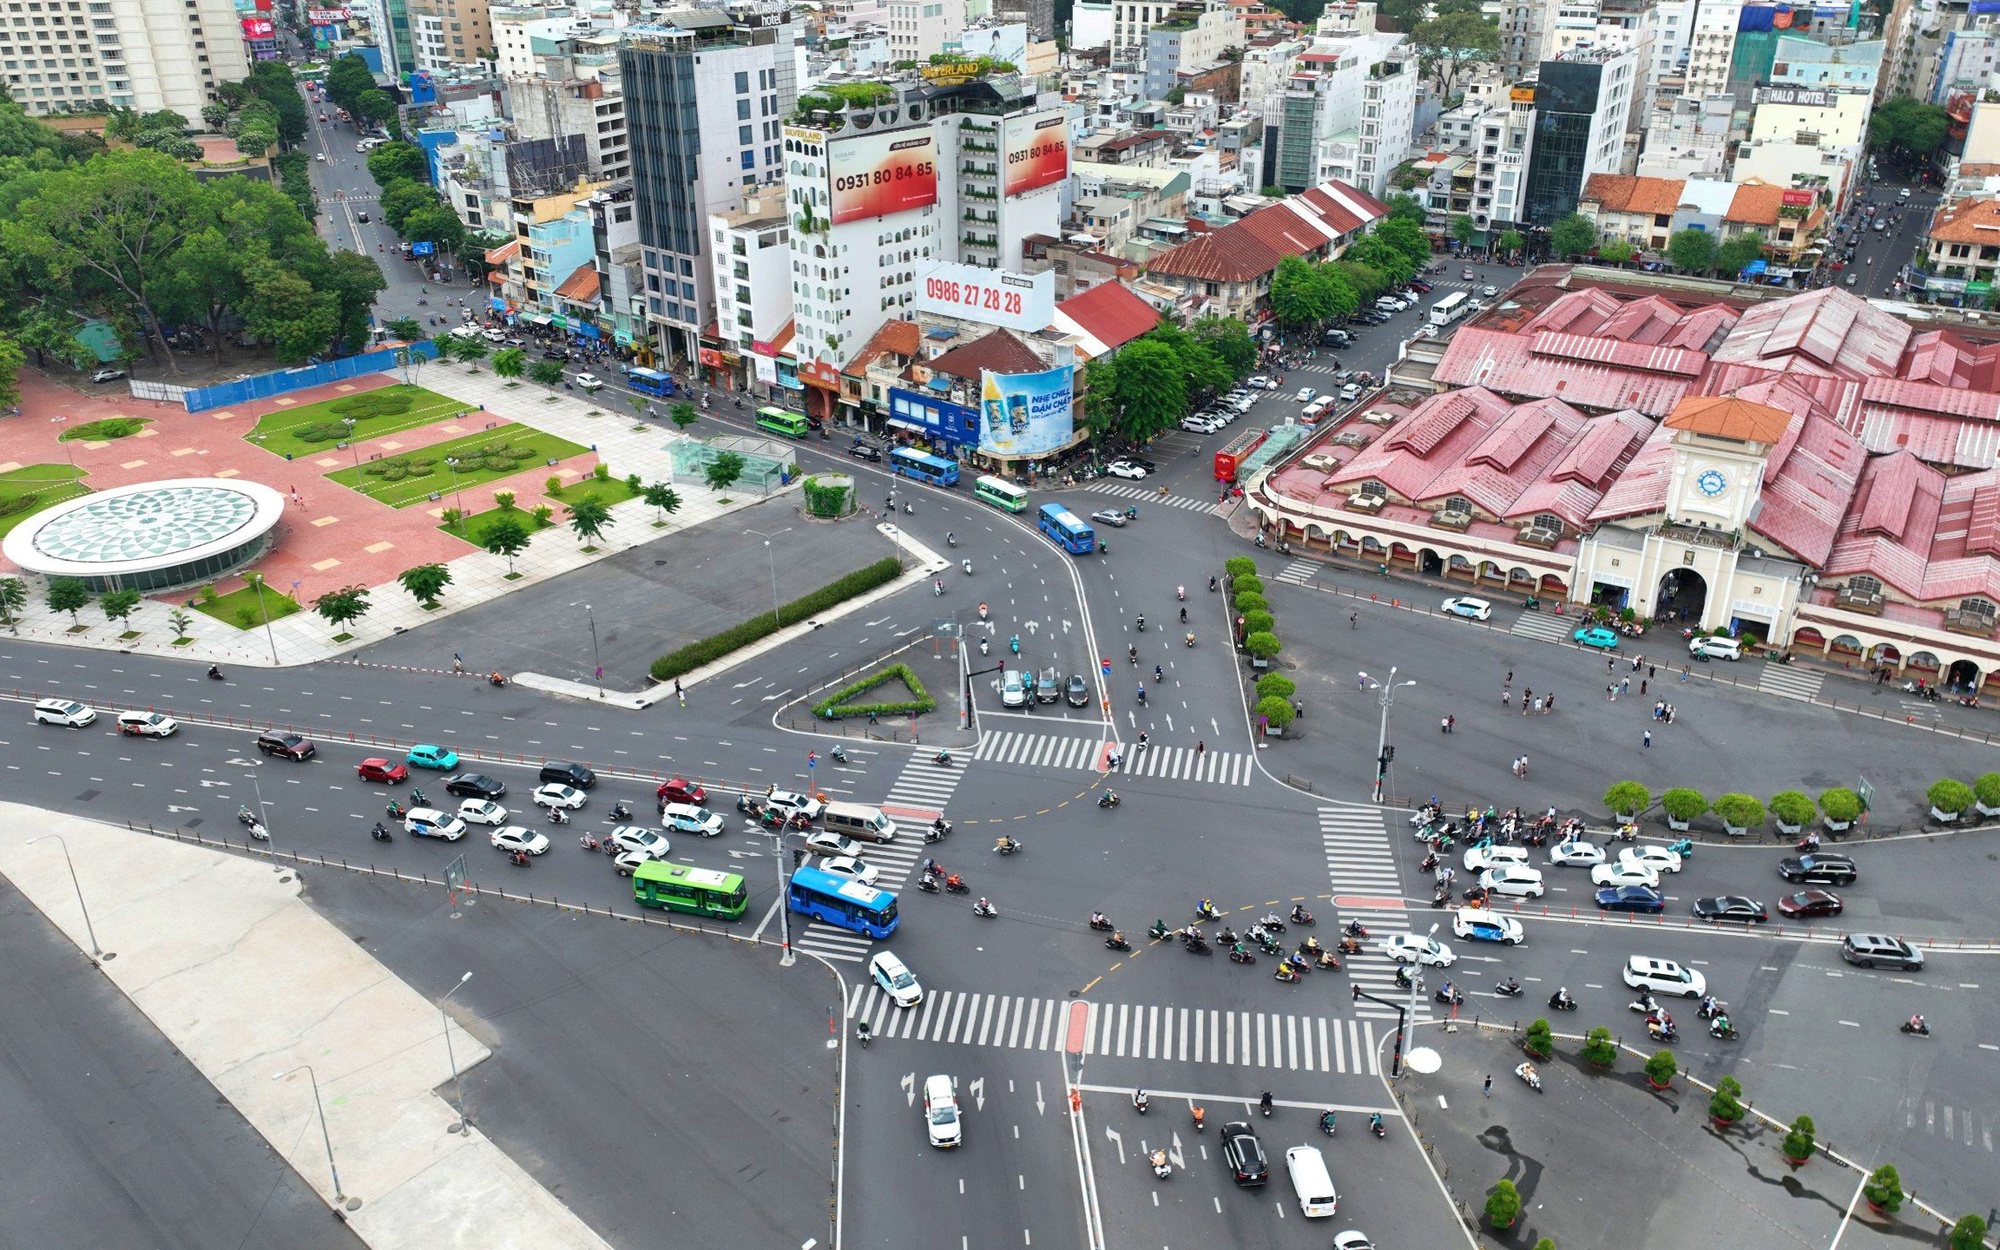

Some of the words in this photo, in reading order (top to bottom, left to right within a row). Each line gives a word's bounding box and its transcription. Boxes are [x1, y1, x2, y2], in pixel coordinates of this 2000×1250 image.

[761, 13, 782, 27] hotel
[921, 62, 979, 78] SILVERLAND
[1770, 89, 1794, 103] HALO
[1797, 91, 1826, 104] HOTEL
[784, 128, 823, 140] SILVERLAND
[1008, 149, 1028, 164] 0931
[1030, 146, 1041, 159] 80
[1042, 143, 1053, 156] 84
[1054, 141, 1065, 153] 85
[836, 172, 869, 192] 0931
[873, 168, 891, 185] 80
[895, 164, 913, 181] 84
[916, 161, 933, 177] 85
[926, 277, 960, 303] 0986
[964, 284, 979, 306] 27
[983, 287, 1000, 311] 28
[1004, 291, 1022, 315] 28
[1051, 387, 1071, 400] CHILL
